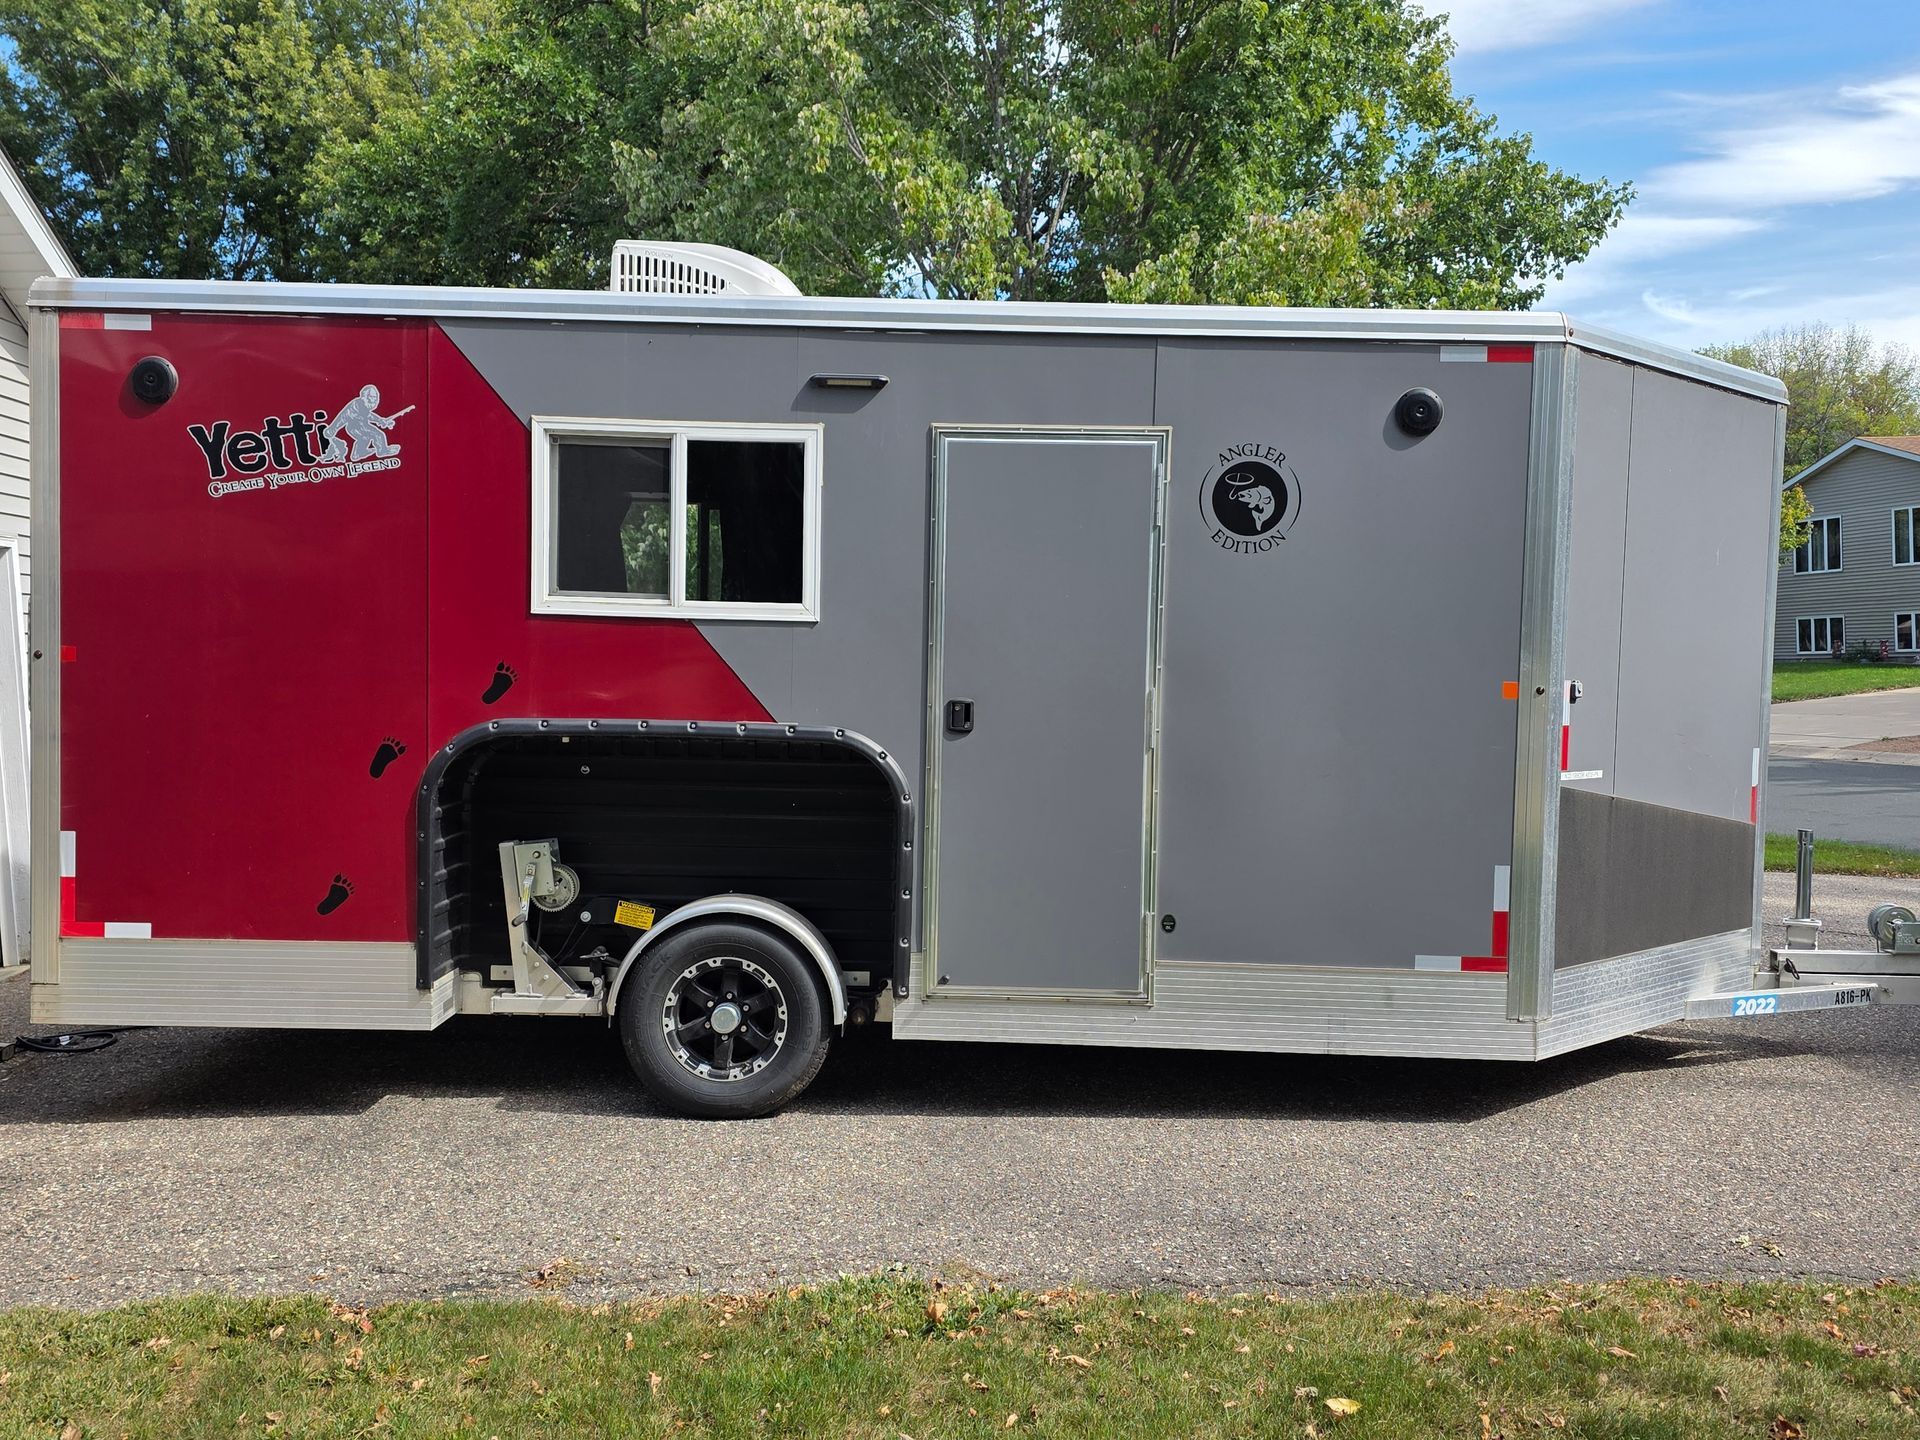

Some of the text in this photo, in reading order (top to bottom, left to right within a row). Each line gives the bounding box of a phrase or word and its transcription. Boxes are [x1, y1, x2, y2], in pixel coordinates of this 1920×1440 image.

[188, 410, 337, 478] Yetti
[1218, 443, 1286, 468] ANGLER
[208, 457, 401, 497] CREATE YOUR OWN LEGEND
[1211, 529, 1287, 554] EDITION
[1735, 998, 1776, 1016] 2022
[1834, 988, 1872, 1006] A816-PK
